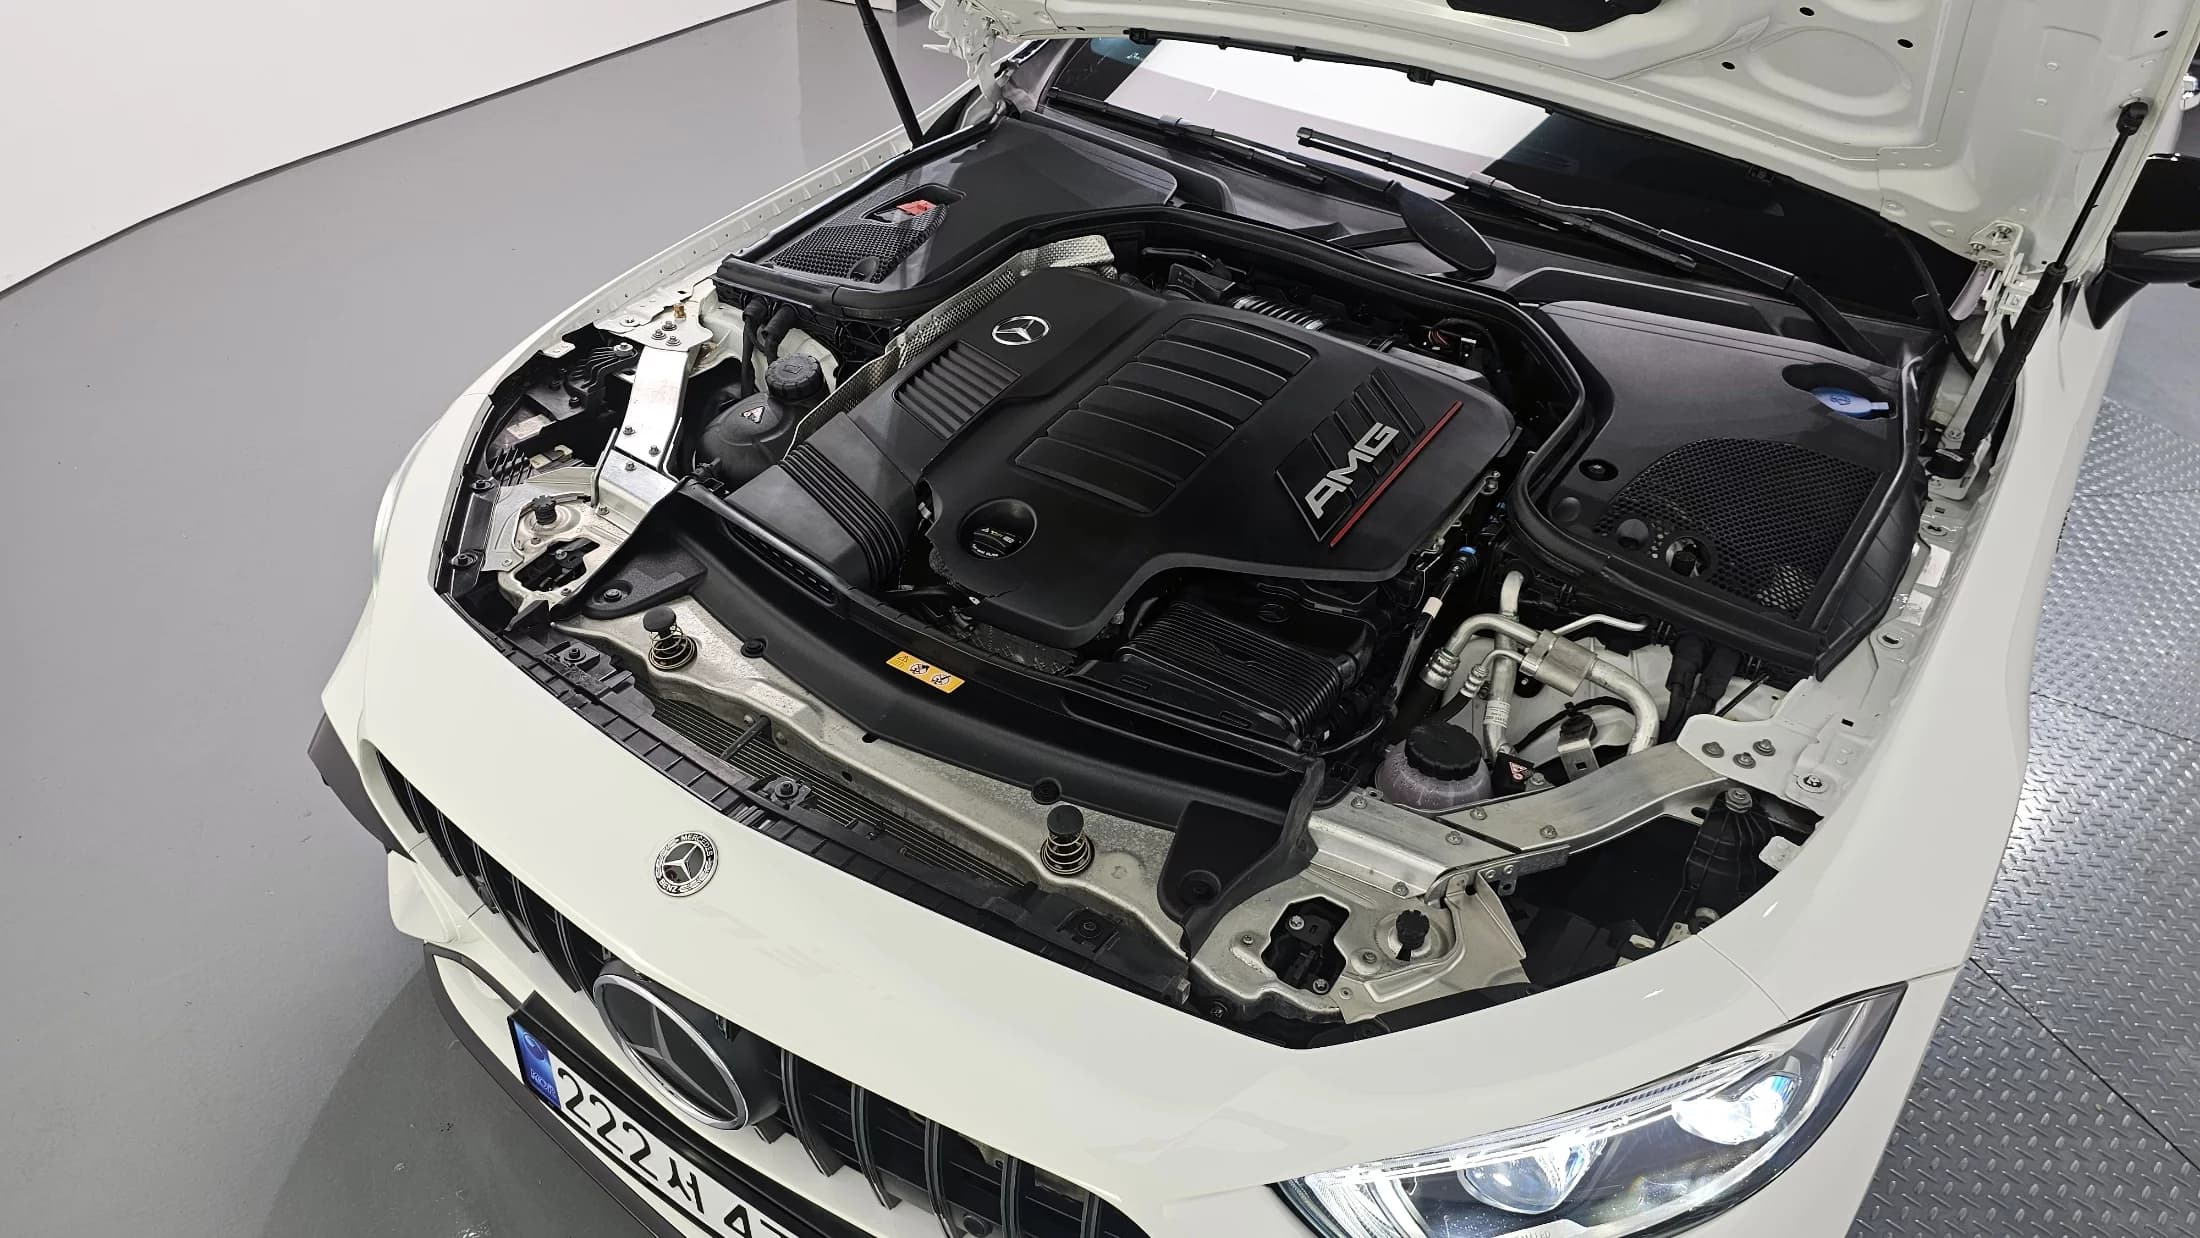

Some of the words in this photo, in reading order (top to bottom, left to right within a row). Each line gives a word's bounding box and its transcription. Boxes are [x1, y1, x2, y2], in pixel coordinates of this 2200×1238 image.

[1304, 422, 1400, 520] AMG
[680, 833, 714, 857] MERCEDES
[658, 878, 678, 893] BENZ
